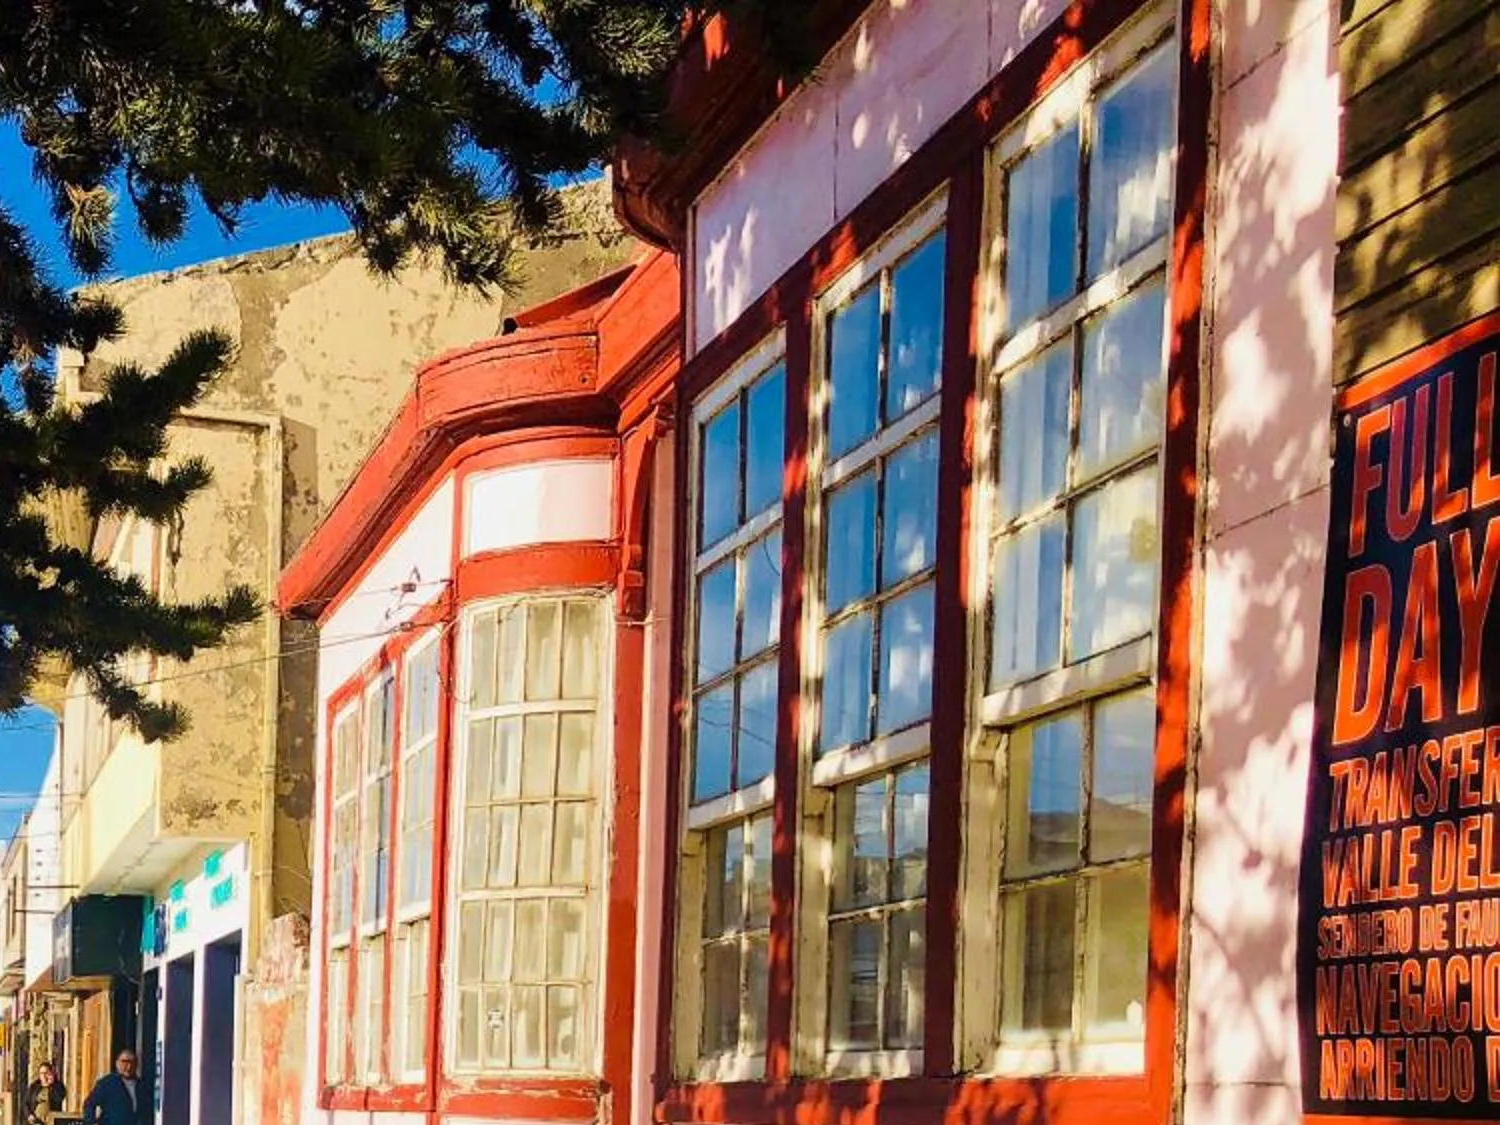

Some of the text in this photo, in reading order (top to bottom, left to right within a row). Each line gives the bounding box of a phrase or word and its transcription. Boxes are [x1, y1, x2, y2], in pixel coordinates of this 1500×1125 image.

[1348, 351, 1500, 558] FULL
[1332, 515, 1500, 746] DAY
[1322, 812, 1500, 908] VALLE DEL
[1317, 908, 1413, 960] SENDERO
[1419, 903, 1449, 951] DE
[1319, 1035, 1475, 1102] ARRIENDO
